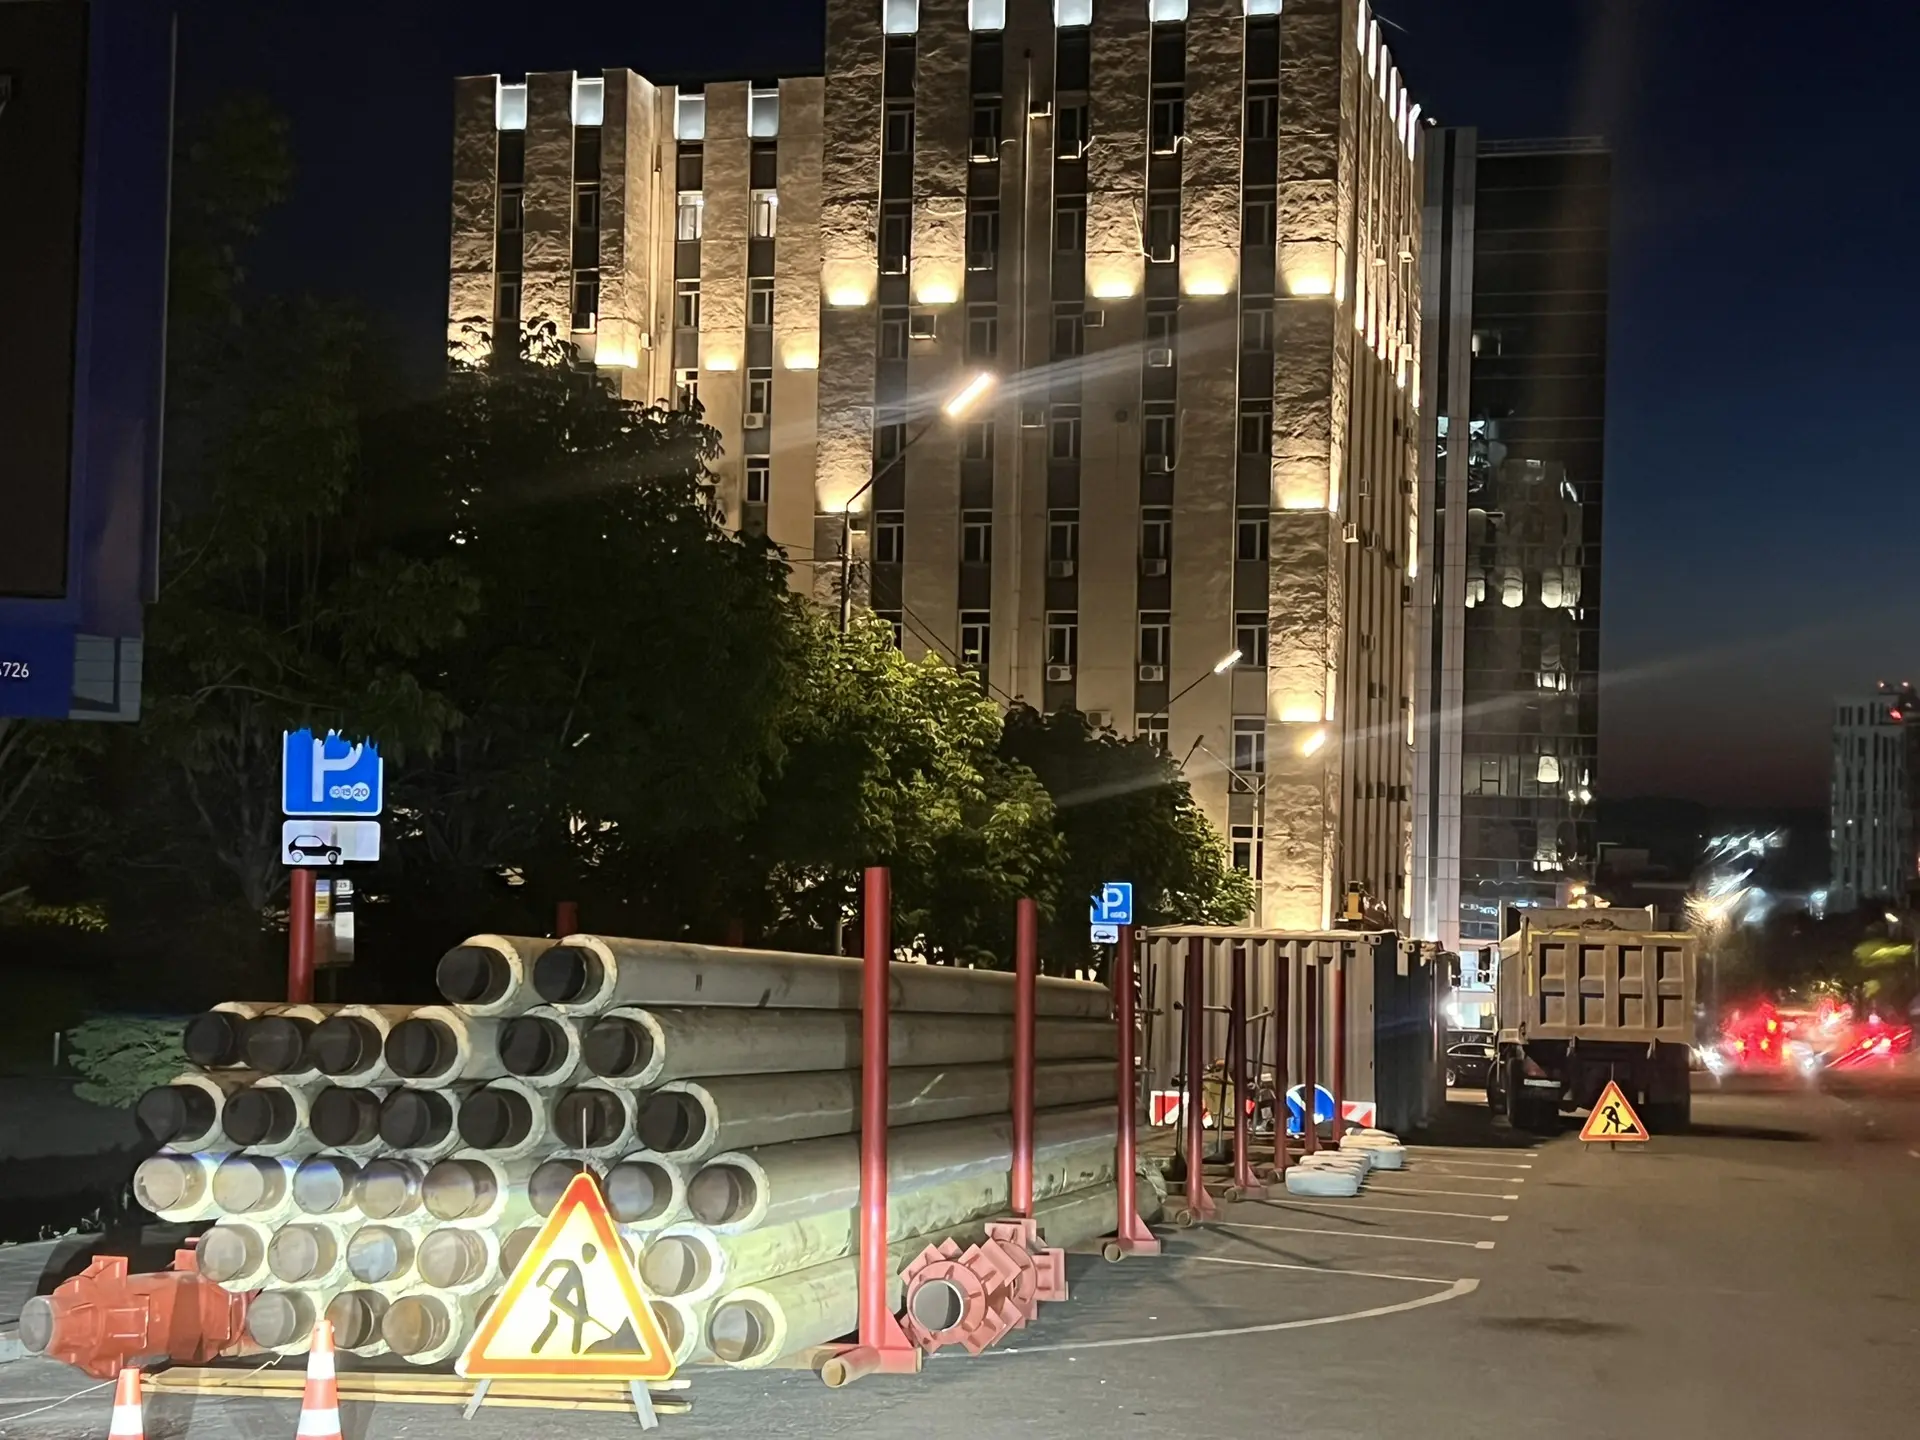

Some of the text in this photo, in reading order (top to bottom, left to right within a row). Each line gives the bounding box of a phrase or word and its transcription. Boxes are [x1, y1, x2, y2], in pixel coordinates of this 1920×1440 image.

[0, 661, 30, 678] 726
[312, 738, 363, 803] P
[353, 787, 369, 797] 20
[1102, 887, 1124, 919] P
